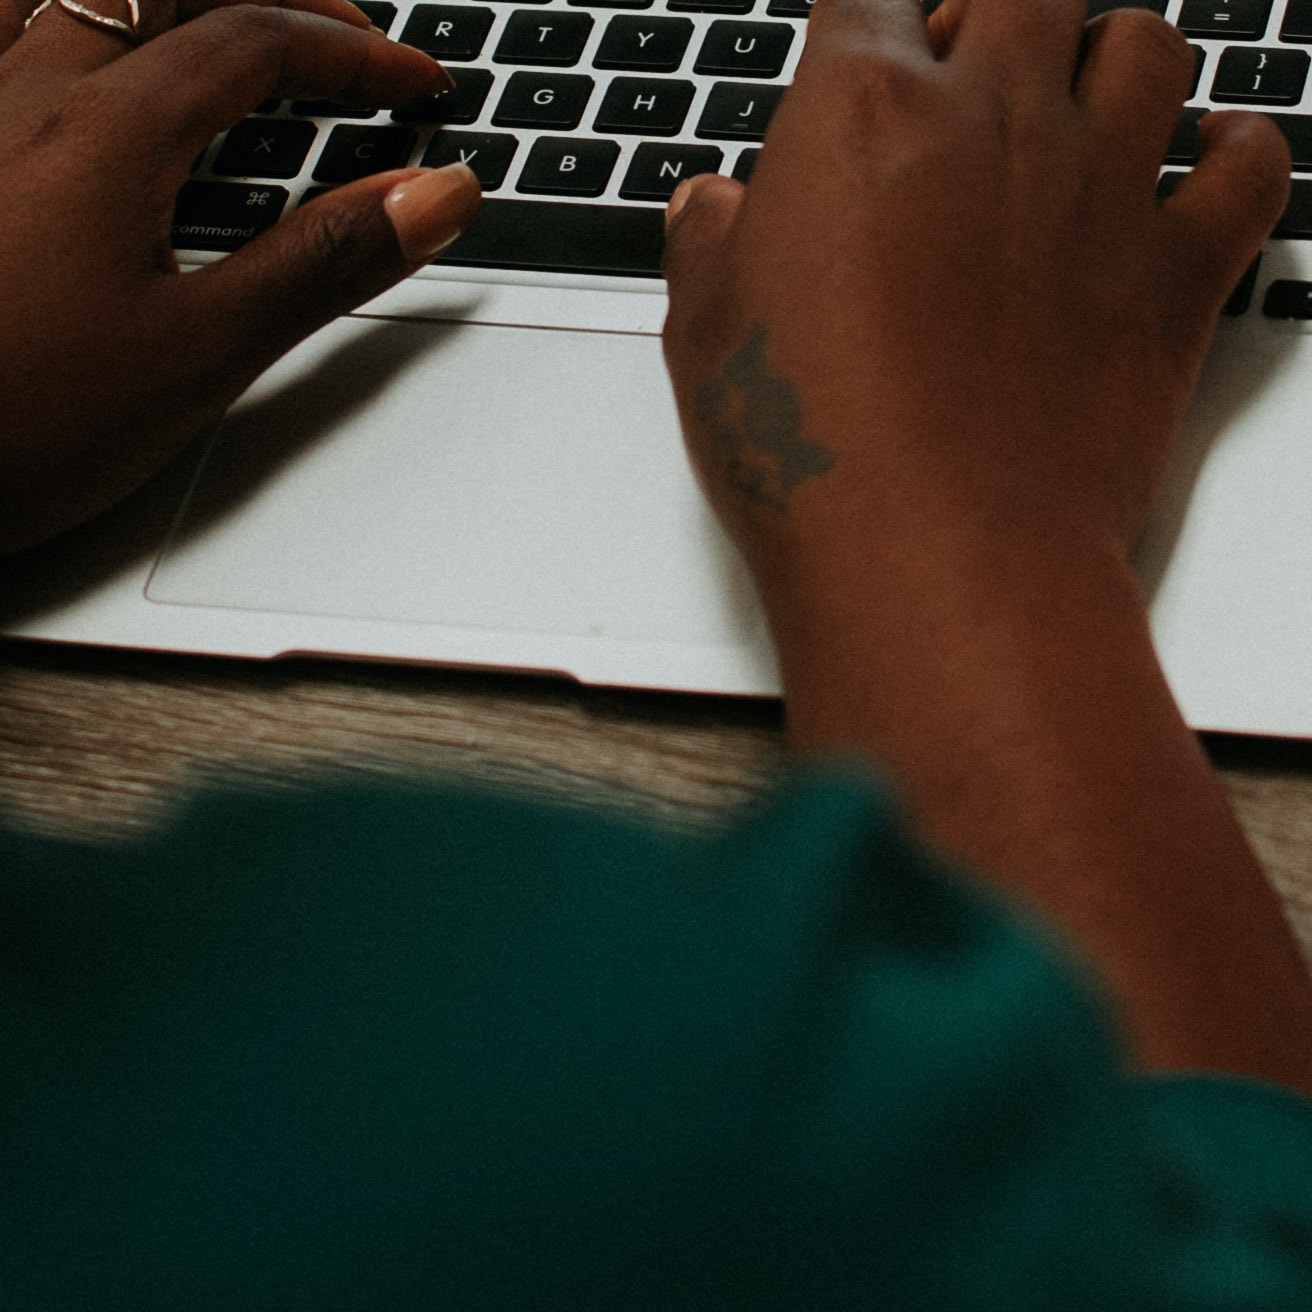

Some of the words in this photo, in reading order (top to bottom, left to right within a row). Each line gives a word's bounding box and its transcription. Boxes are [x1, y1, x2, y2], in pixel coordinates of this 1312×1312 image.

[434, 21, 453, 37] R
[537, 27, 553, 42] T
[637, 32, 654, 48] Y
[734, 37, 756, 54] U
[533, 90, 554, 105] G
[633, 95, 656, 111] H
[739, 101, 754, 118] J
[558, 156, 577, 172] B
[660, 162, 683, 179] N
